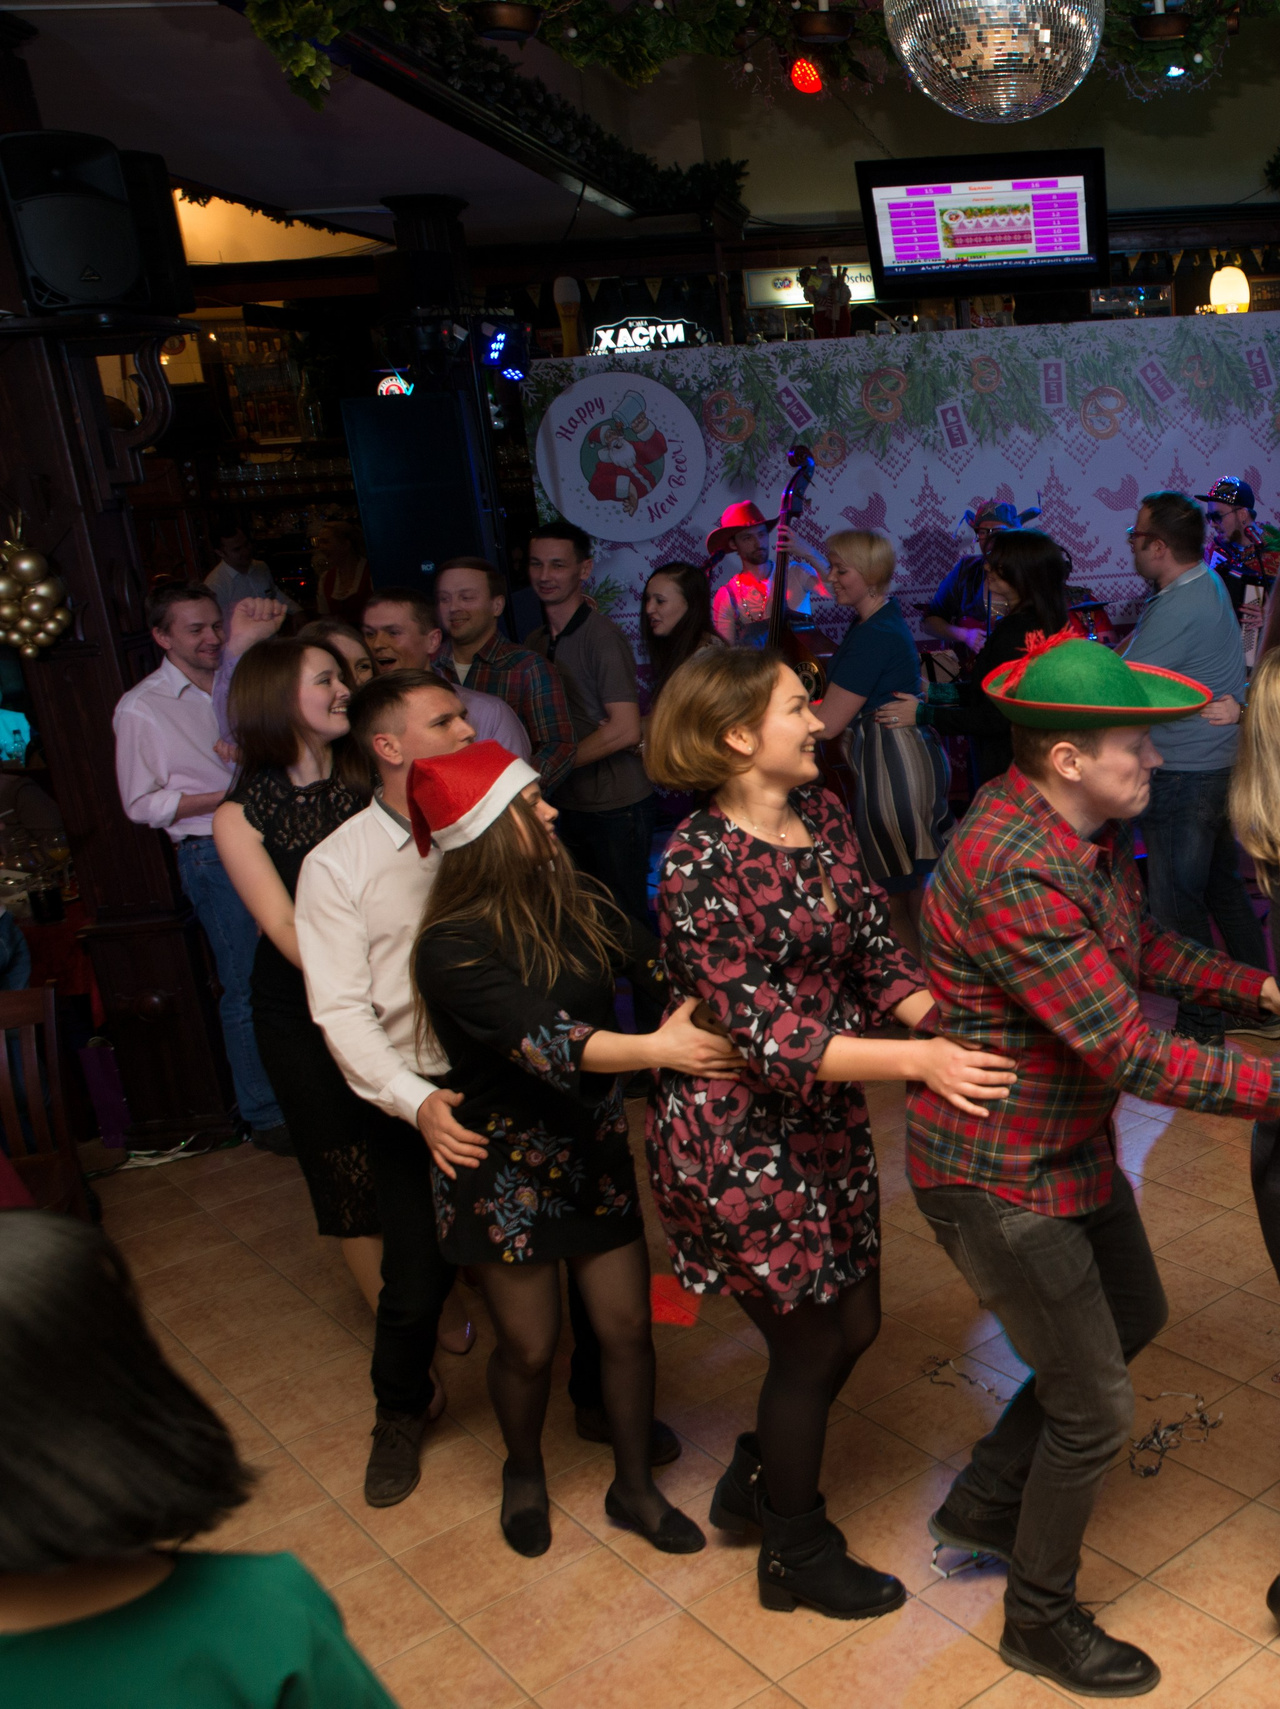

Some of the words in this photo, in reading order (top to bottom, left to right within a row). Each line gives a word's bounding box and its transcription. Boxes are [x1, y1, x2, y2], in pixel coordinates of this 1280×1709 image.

[596, 323, 686, 349] ХАСКИ
[555, 396, 606, 442] Happy
[646, 491, 679, 524] New
[667, 437, 688, 490] Beer!
